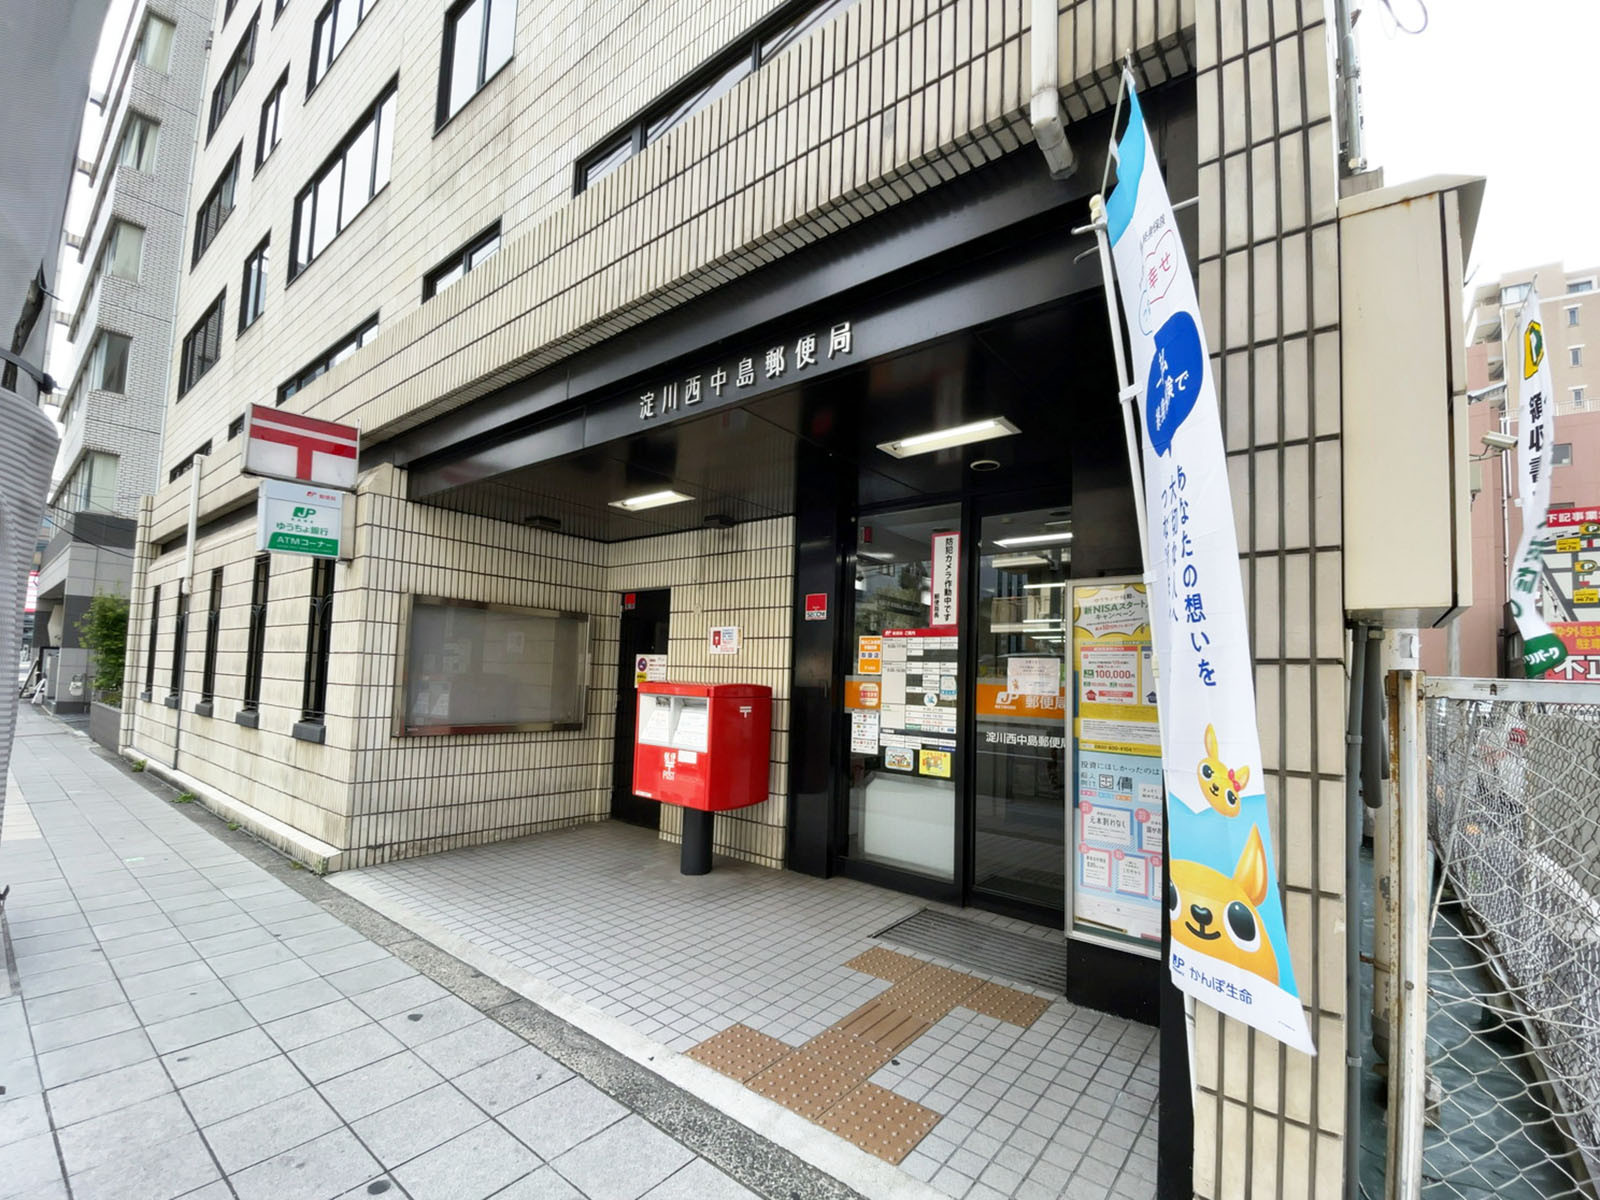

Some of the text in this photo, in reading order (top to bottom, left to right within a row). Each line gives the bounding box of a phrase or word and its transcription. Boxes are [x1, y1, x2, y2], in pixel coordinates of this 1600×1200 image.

[639, 322, 851, 420] 淀川西中島郵便局
[292, 506, 317, 519] JP
[1547, 510, 1600, 524] 下記事業
[276, 522, 329, 537] ゆうちょ銀行
[276, 535, 333, 548] ATMコーナー
[1176, 465, 1217, 687] あなたの想いを
[1189, 966, 1253, 1006] かんぽ生命
